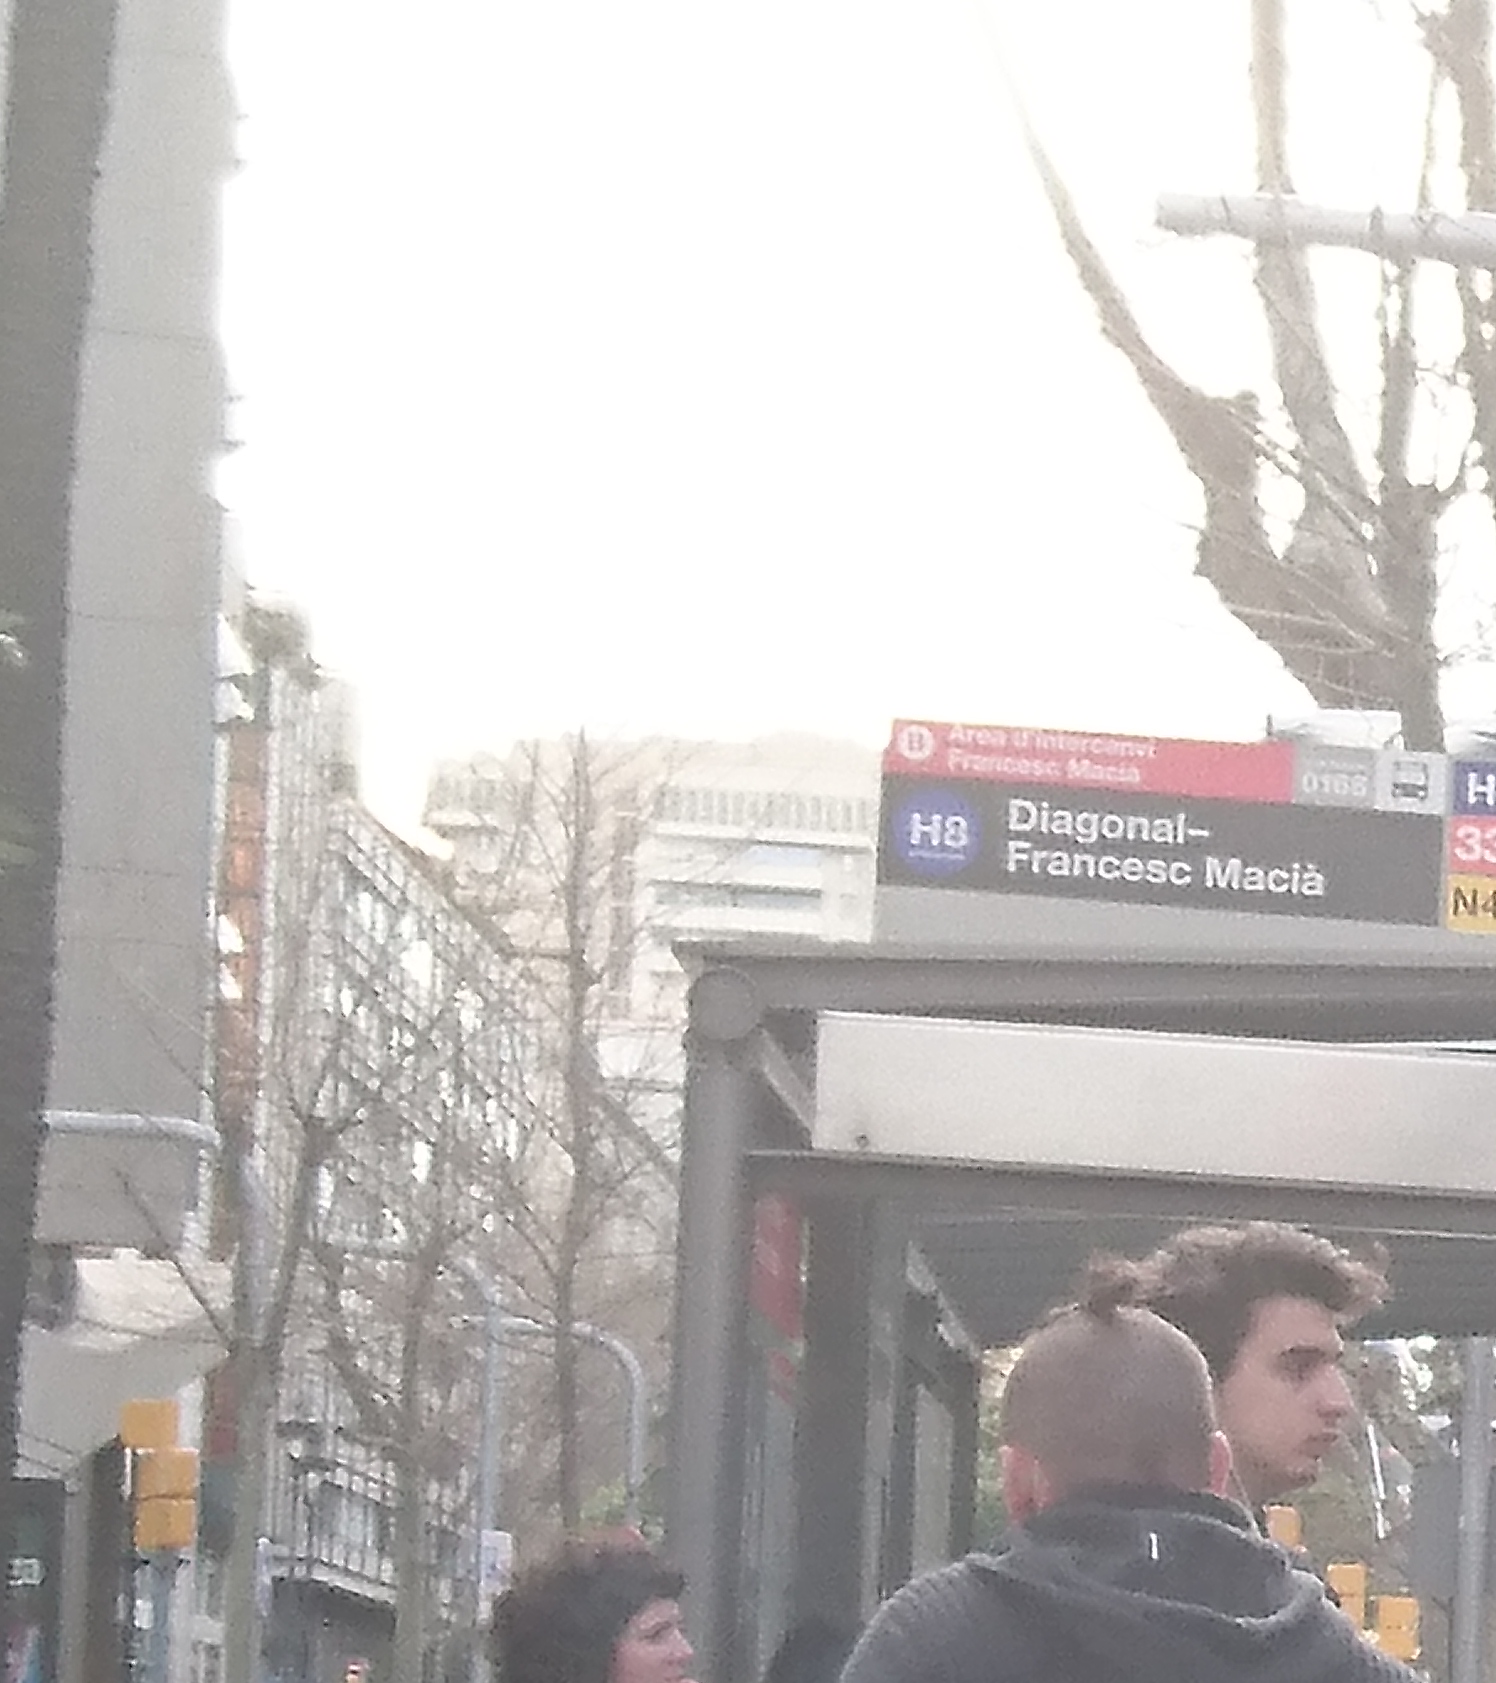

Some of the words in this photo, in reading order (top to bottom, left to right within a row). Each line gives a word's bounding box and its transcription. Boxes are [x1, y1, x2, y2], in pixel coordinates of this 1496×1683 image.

[947, 748, 1063, 776] Francesc
[908, 811, 969, 848] H8
[1006, 841, 1193, 887] Francesc
[1204, 856, 1326, 897] Macià
